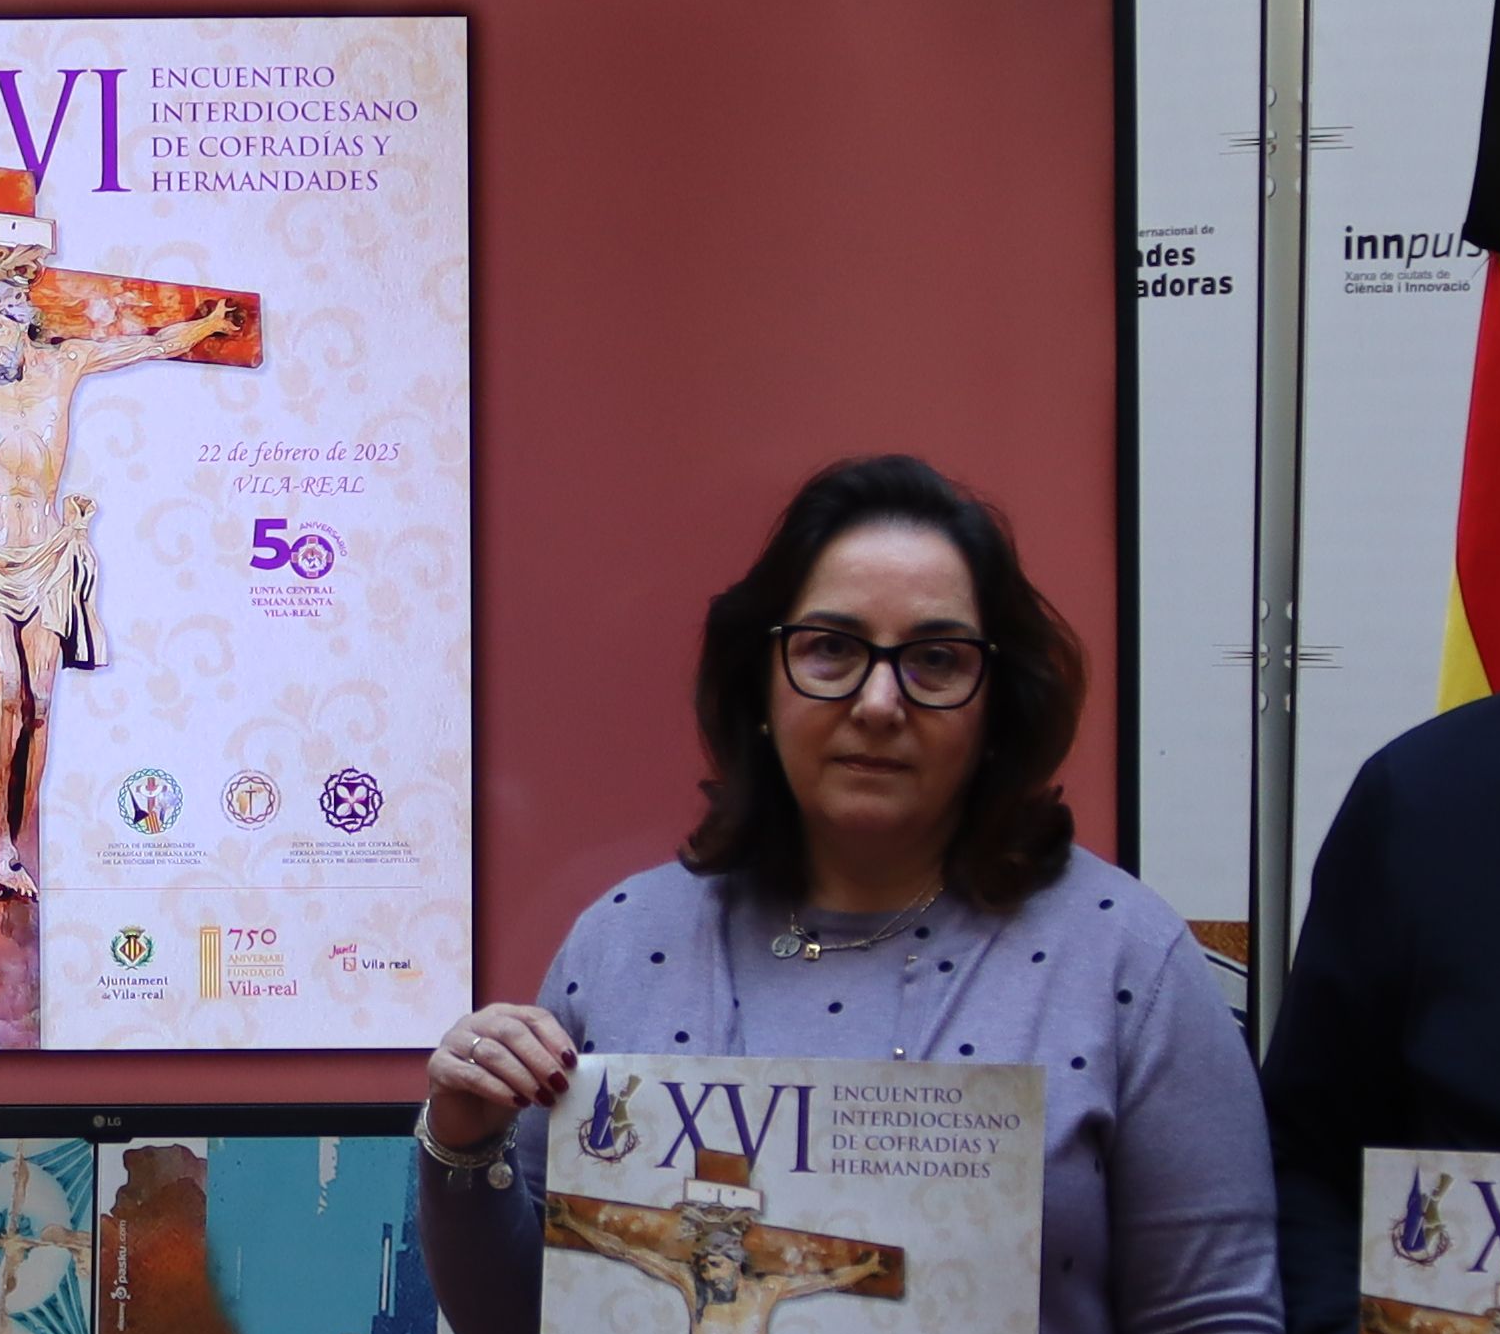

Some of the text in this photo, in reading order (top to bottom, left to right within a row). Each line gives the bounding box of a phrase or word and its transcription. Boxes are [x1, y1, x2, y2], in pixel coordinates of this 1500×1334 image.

[151, 67, 335, 88] ENCUENTRO
[151, 100, 418, 122] INTERDIOCESANO
[151, 131, 390, 157] DE COFRADÍAS Y
[151, 170, 379, 192] HERMANDADES
[1201, 225, 1215, 235] de
[1380, 270, 1394, 281] de
[1397, 270, 1436, 281] ciutats
[1344, 281, 1394, 294] Ciència
[1405, 279, 1471, 293] Innovació
[198, 441, 400, 467] 22 de febrero de 2025
[233, 475, 365, 497] VILA-REAL
[249, 586, 335, 595] JUNTA CENTRAL
[252, 598, 333, 606] SEMANA SANTA
[264, 609, 320, 617] VILA-REAL
[227, 928, 277, 951] 750
[97, 975, 169, 988] Ajuntament
[228, 980, 298, 996] Vila-real
[112, 989, 164, 1001] Vila-real
[832, 1085, 963, 1104] ENCUENTRO
[107, 1117, 121, 1126] LG
[656, 1082, 817, 1172] XVI
[832, 1109, 1020, 1129] INTERDIOCESANO
[831, 1130, 1000, 1154] DE COFRADÍAS Y
[832, 1159, 990, 1178] HERMANDADES
